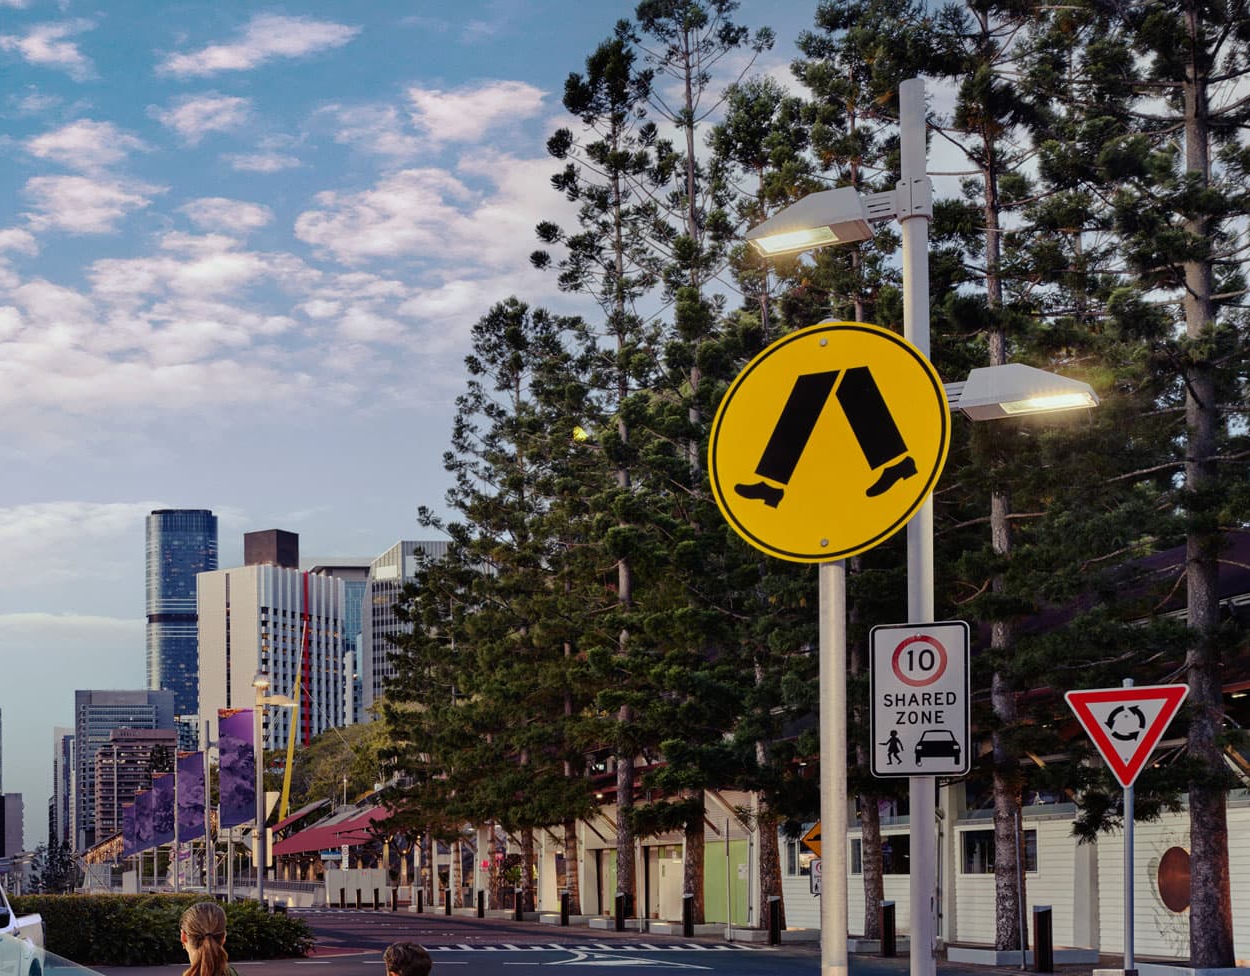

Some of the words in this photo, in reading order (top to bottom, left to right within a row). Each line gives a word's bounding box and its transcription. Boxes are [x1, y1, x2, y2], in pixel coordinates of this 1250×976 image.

[907, 649, 935, 671] 10
[883, 691, 957, 707] SHARED
[895, 710, 945, 725] ZONE
